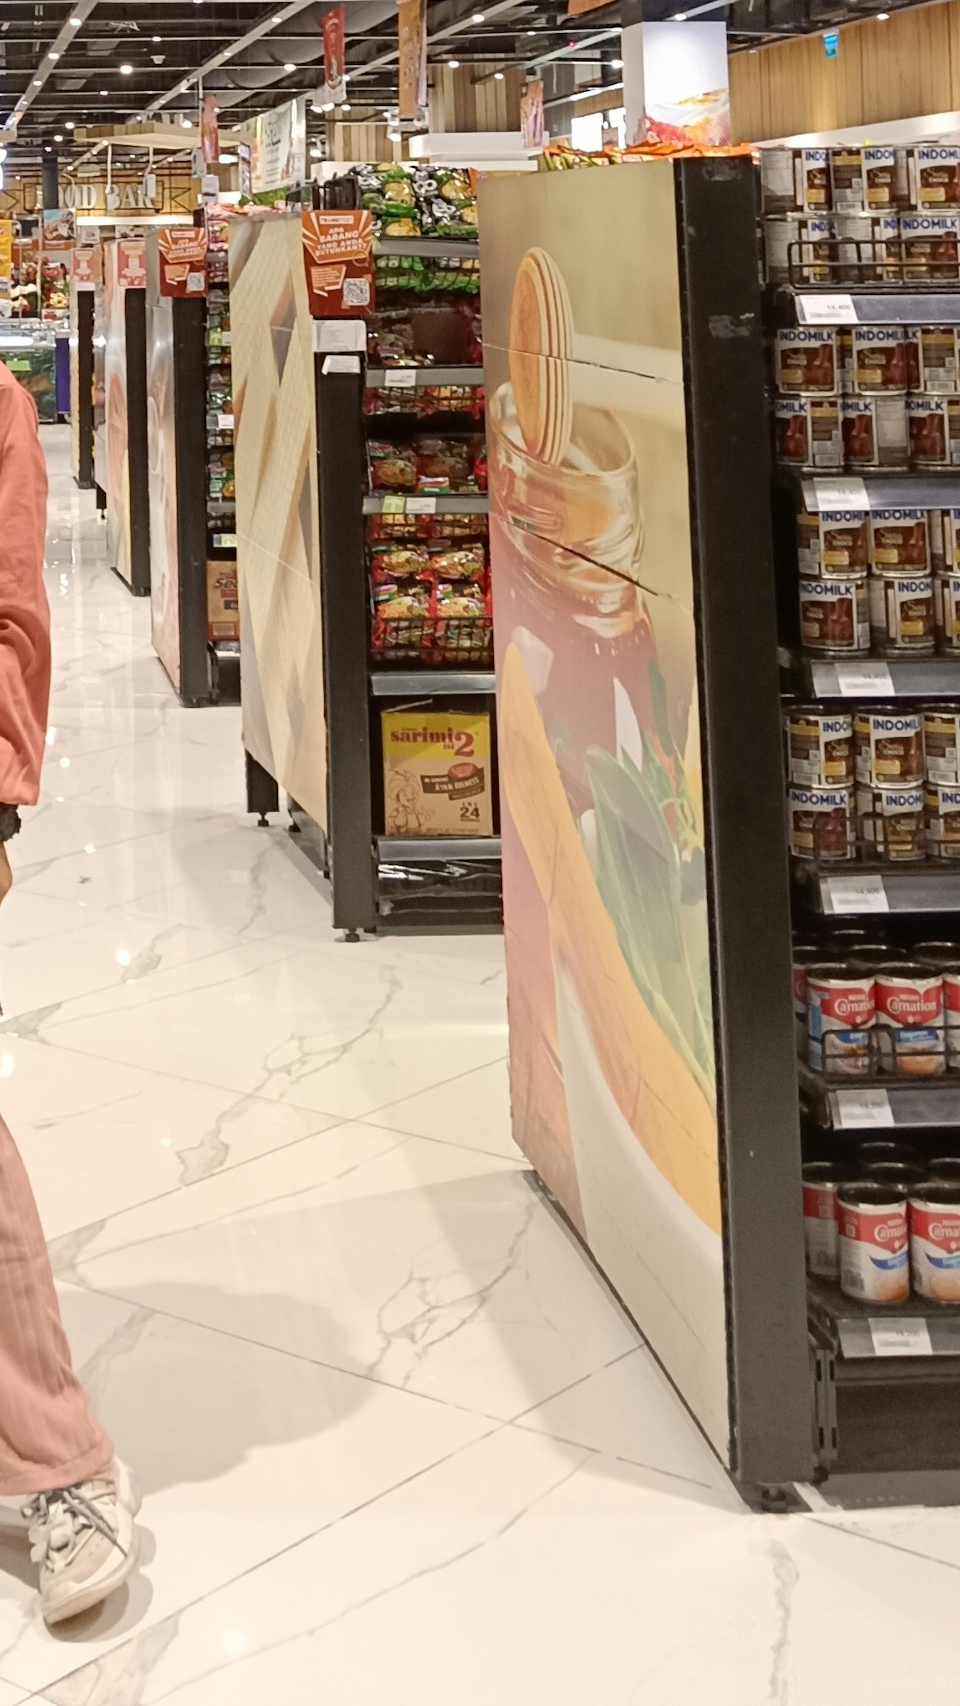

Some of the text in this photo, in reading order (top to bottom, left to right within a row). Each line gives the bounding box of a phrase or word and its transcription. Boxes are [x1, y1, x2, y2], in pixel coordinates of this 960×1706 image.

[106, 182, 155, 210] BAR
[390, 727, 453, 743] sarimi
[460, 806, 480, 819] 24
[886, 996, 937, 1014] Carnation
